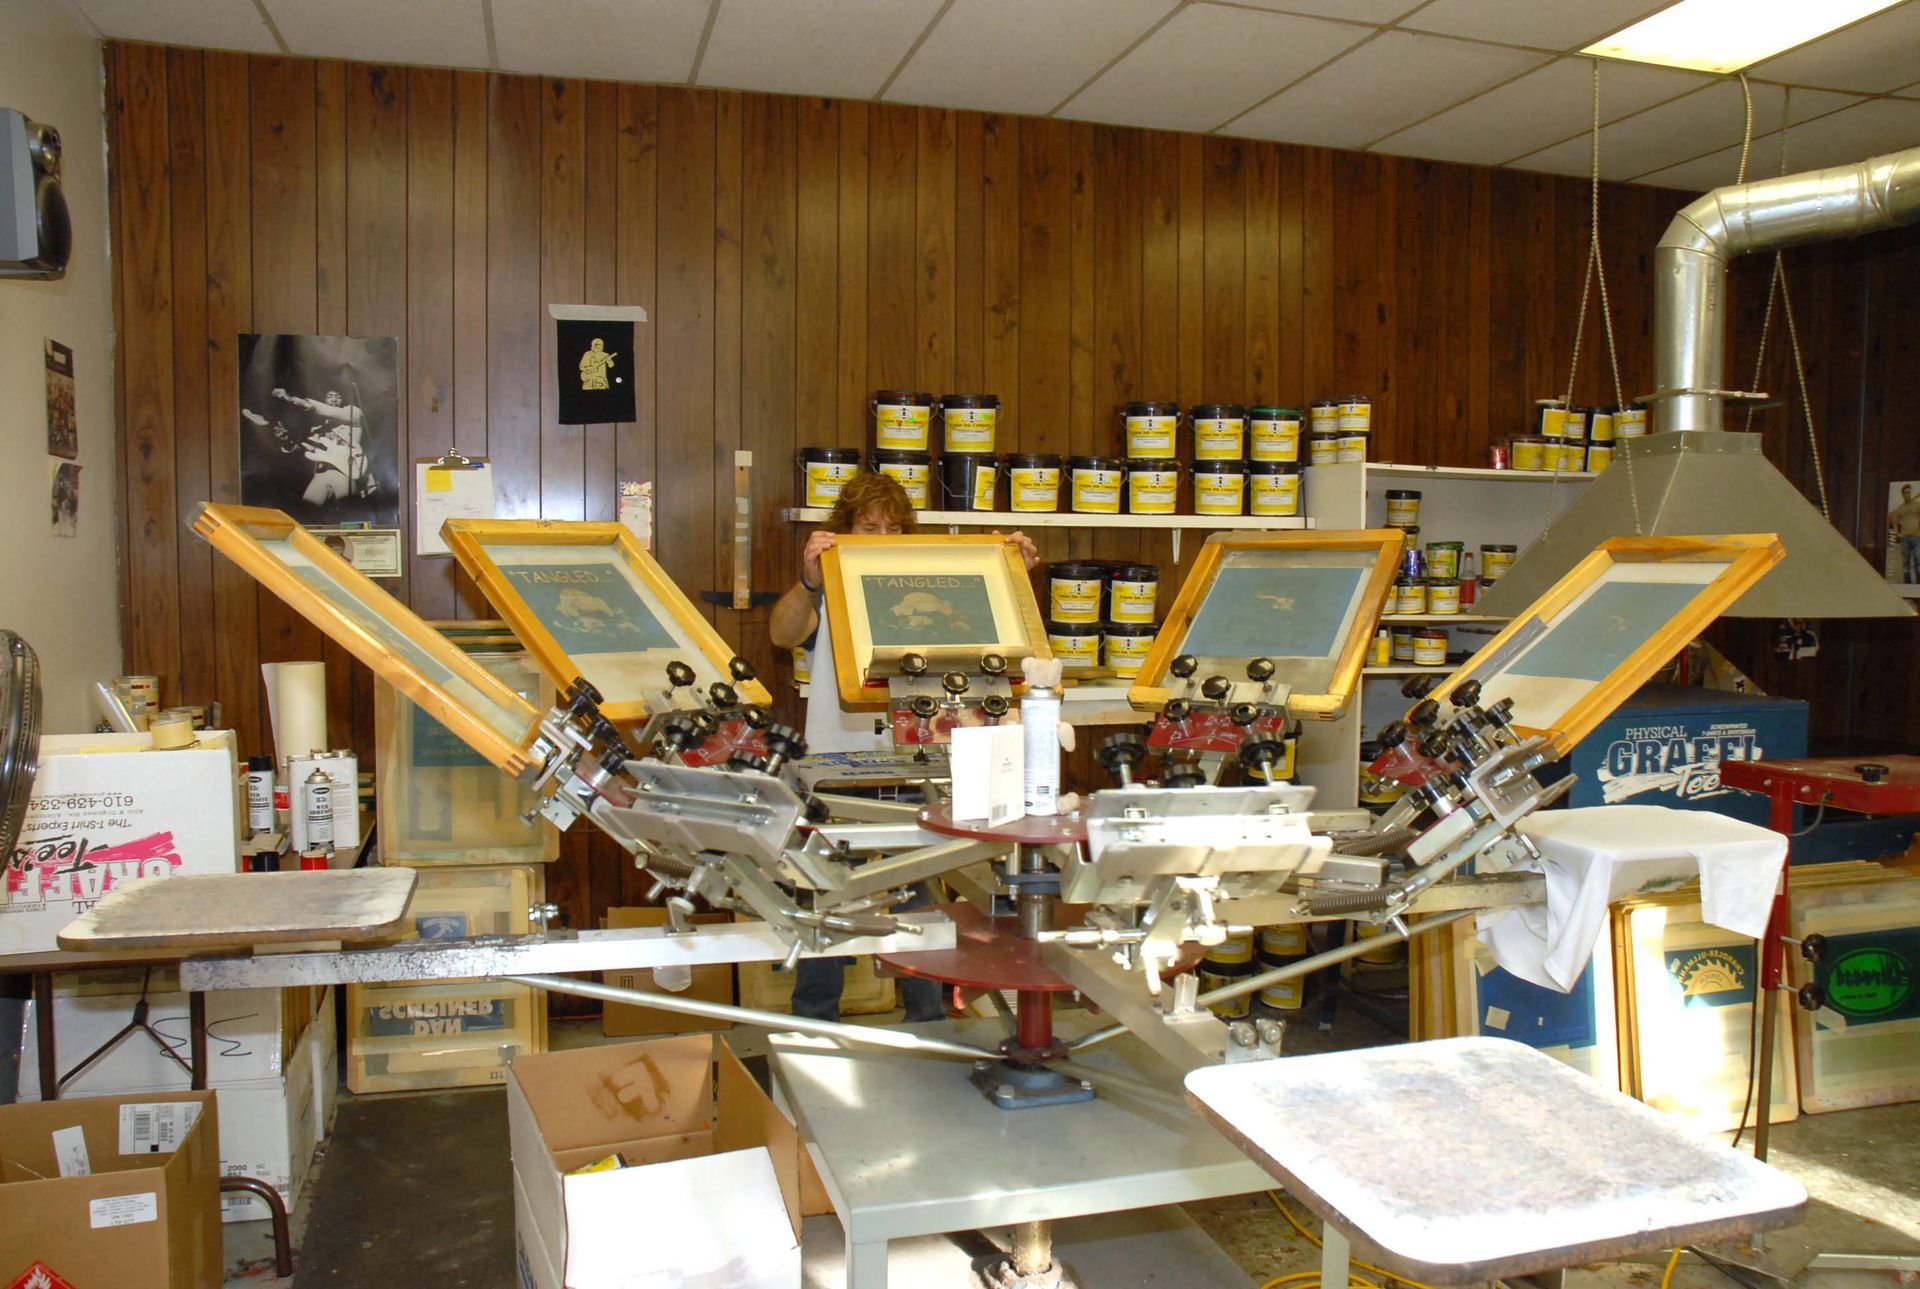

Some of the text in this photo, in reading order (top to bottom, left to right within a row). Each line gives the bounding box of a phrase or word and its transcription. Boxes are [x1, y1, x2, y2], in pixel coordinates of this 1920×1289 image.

[864, 577, 980, 588] "TANGLED..."
[1625, 725, 1687, 741] PHYSICAL
[28, 795, 134, 812] 610-439-334
[71, 819, 104, 830] T-Shirt
